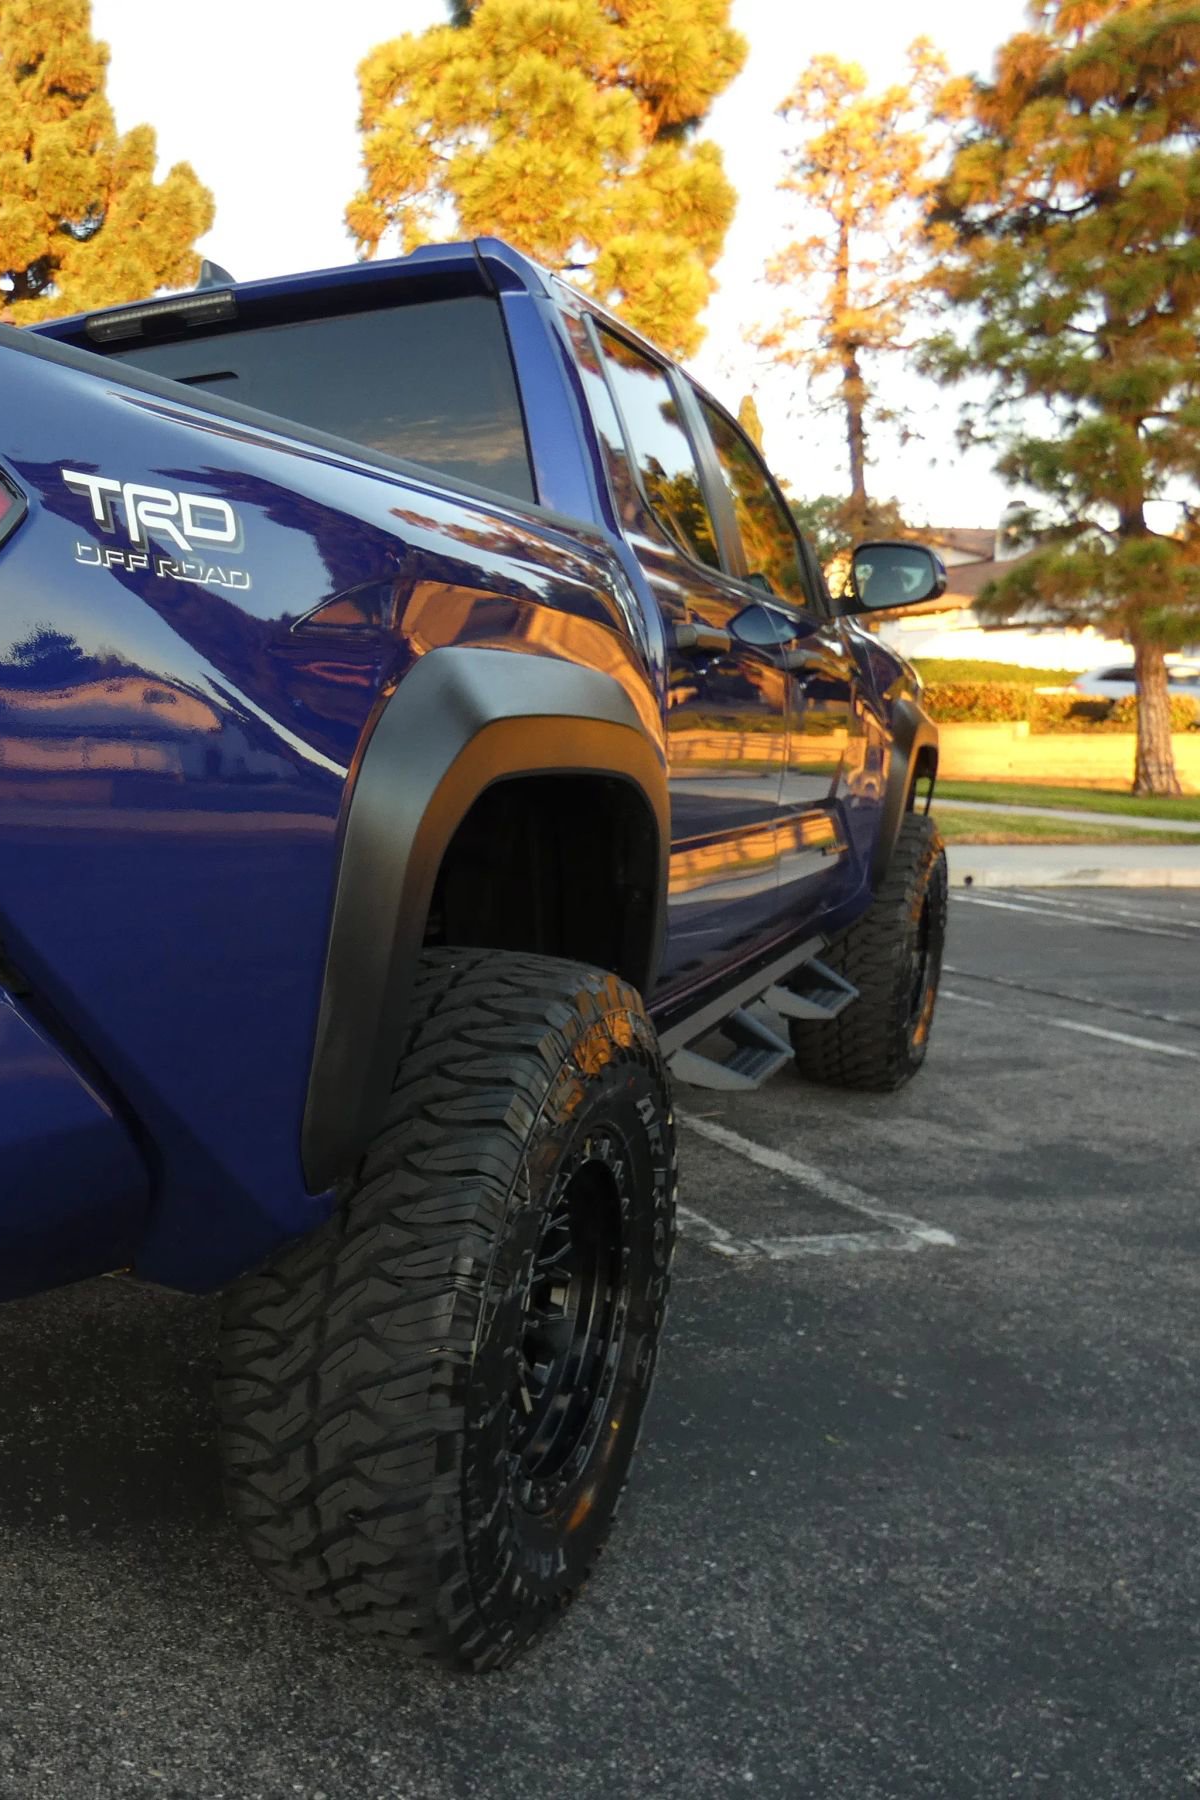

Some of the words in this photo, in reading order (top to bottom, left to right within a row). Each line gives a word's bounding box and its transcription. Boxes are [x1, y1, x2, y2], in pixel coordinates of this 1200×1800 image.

[61, 468, 240, 552] TRD
[75, 541, 150, 572] OFF
[155, 557, 252, 590] ROAD
